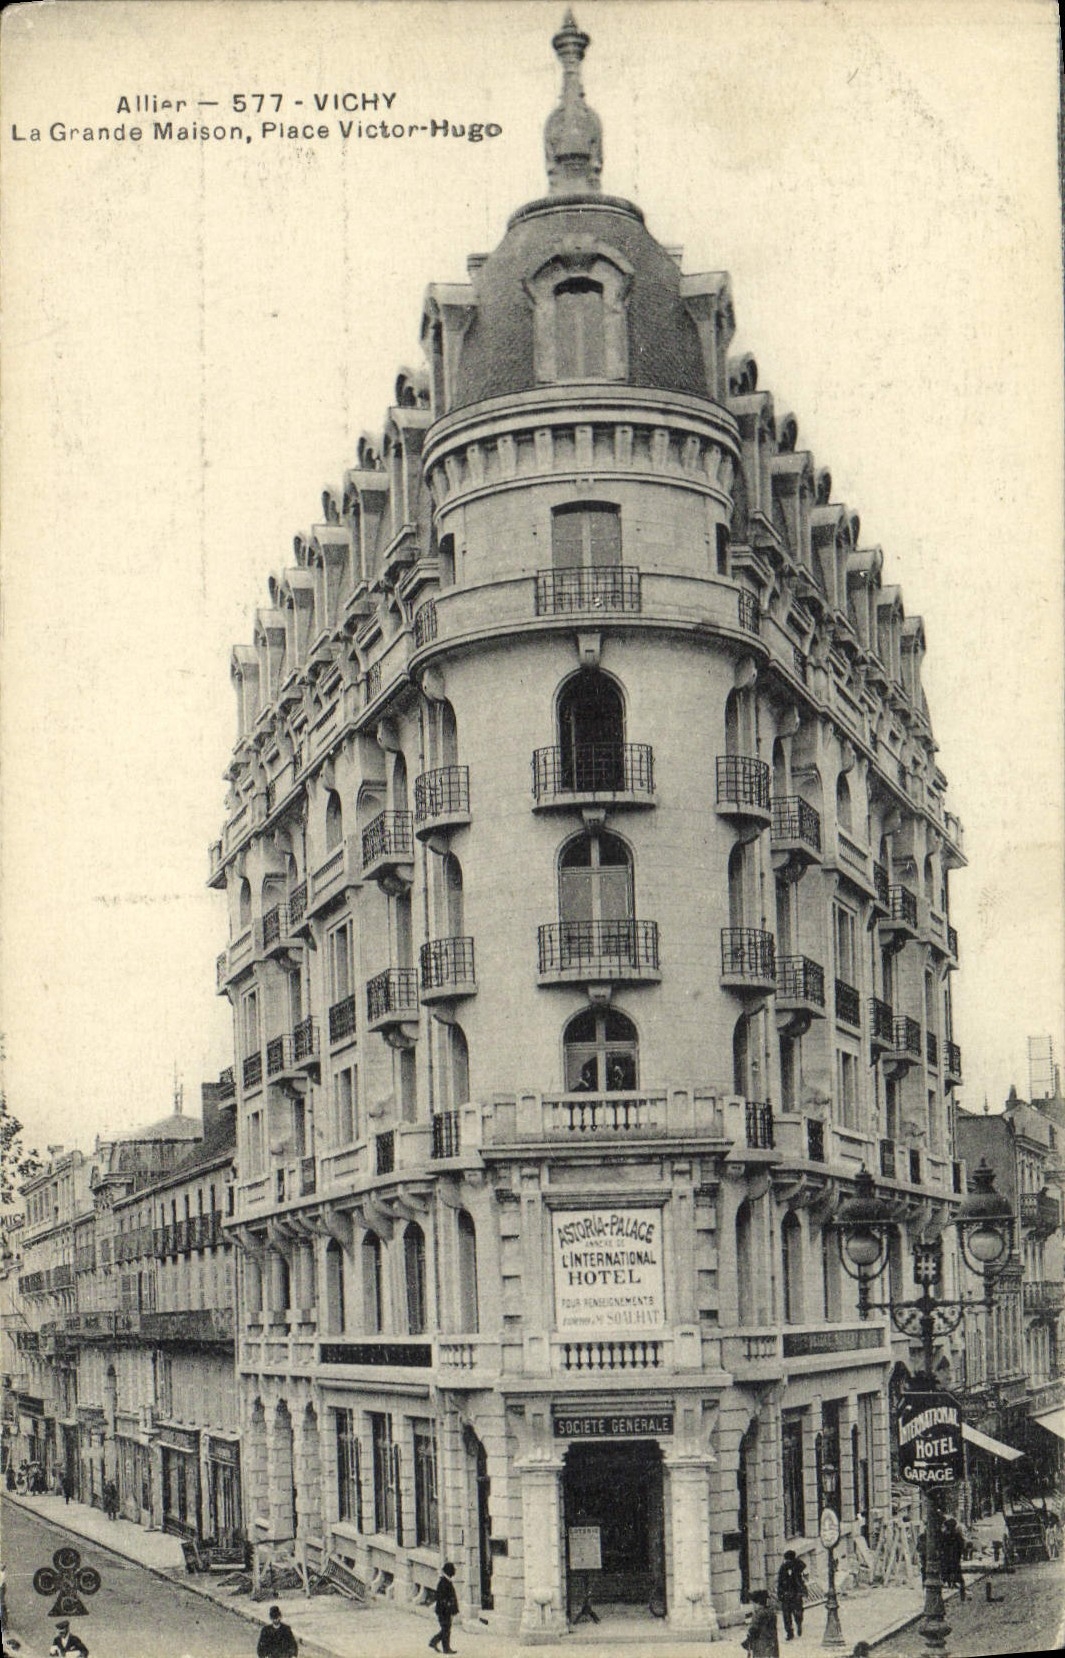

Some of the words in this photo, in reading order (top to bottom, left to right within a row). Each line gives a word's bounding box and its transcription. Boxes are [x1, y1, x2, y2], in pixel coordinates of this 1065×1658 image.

[568, 1269, 642, 1286] HOTEL
[898, 1406, 960, 1446] INTERNATIONAL
[915, 1436, 958, 1460] HOTEL
[904, 1465, 955, 1482] GARAGE
